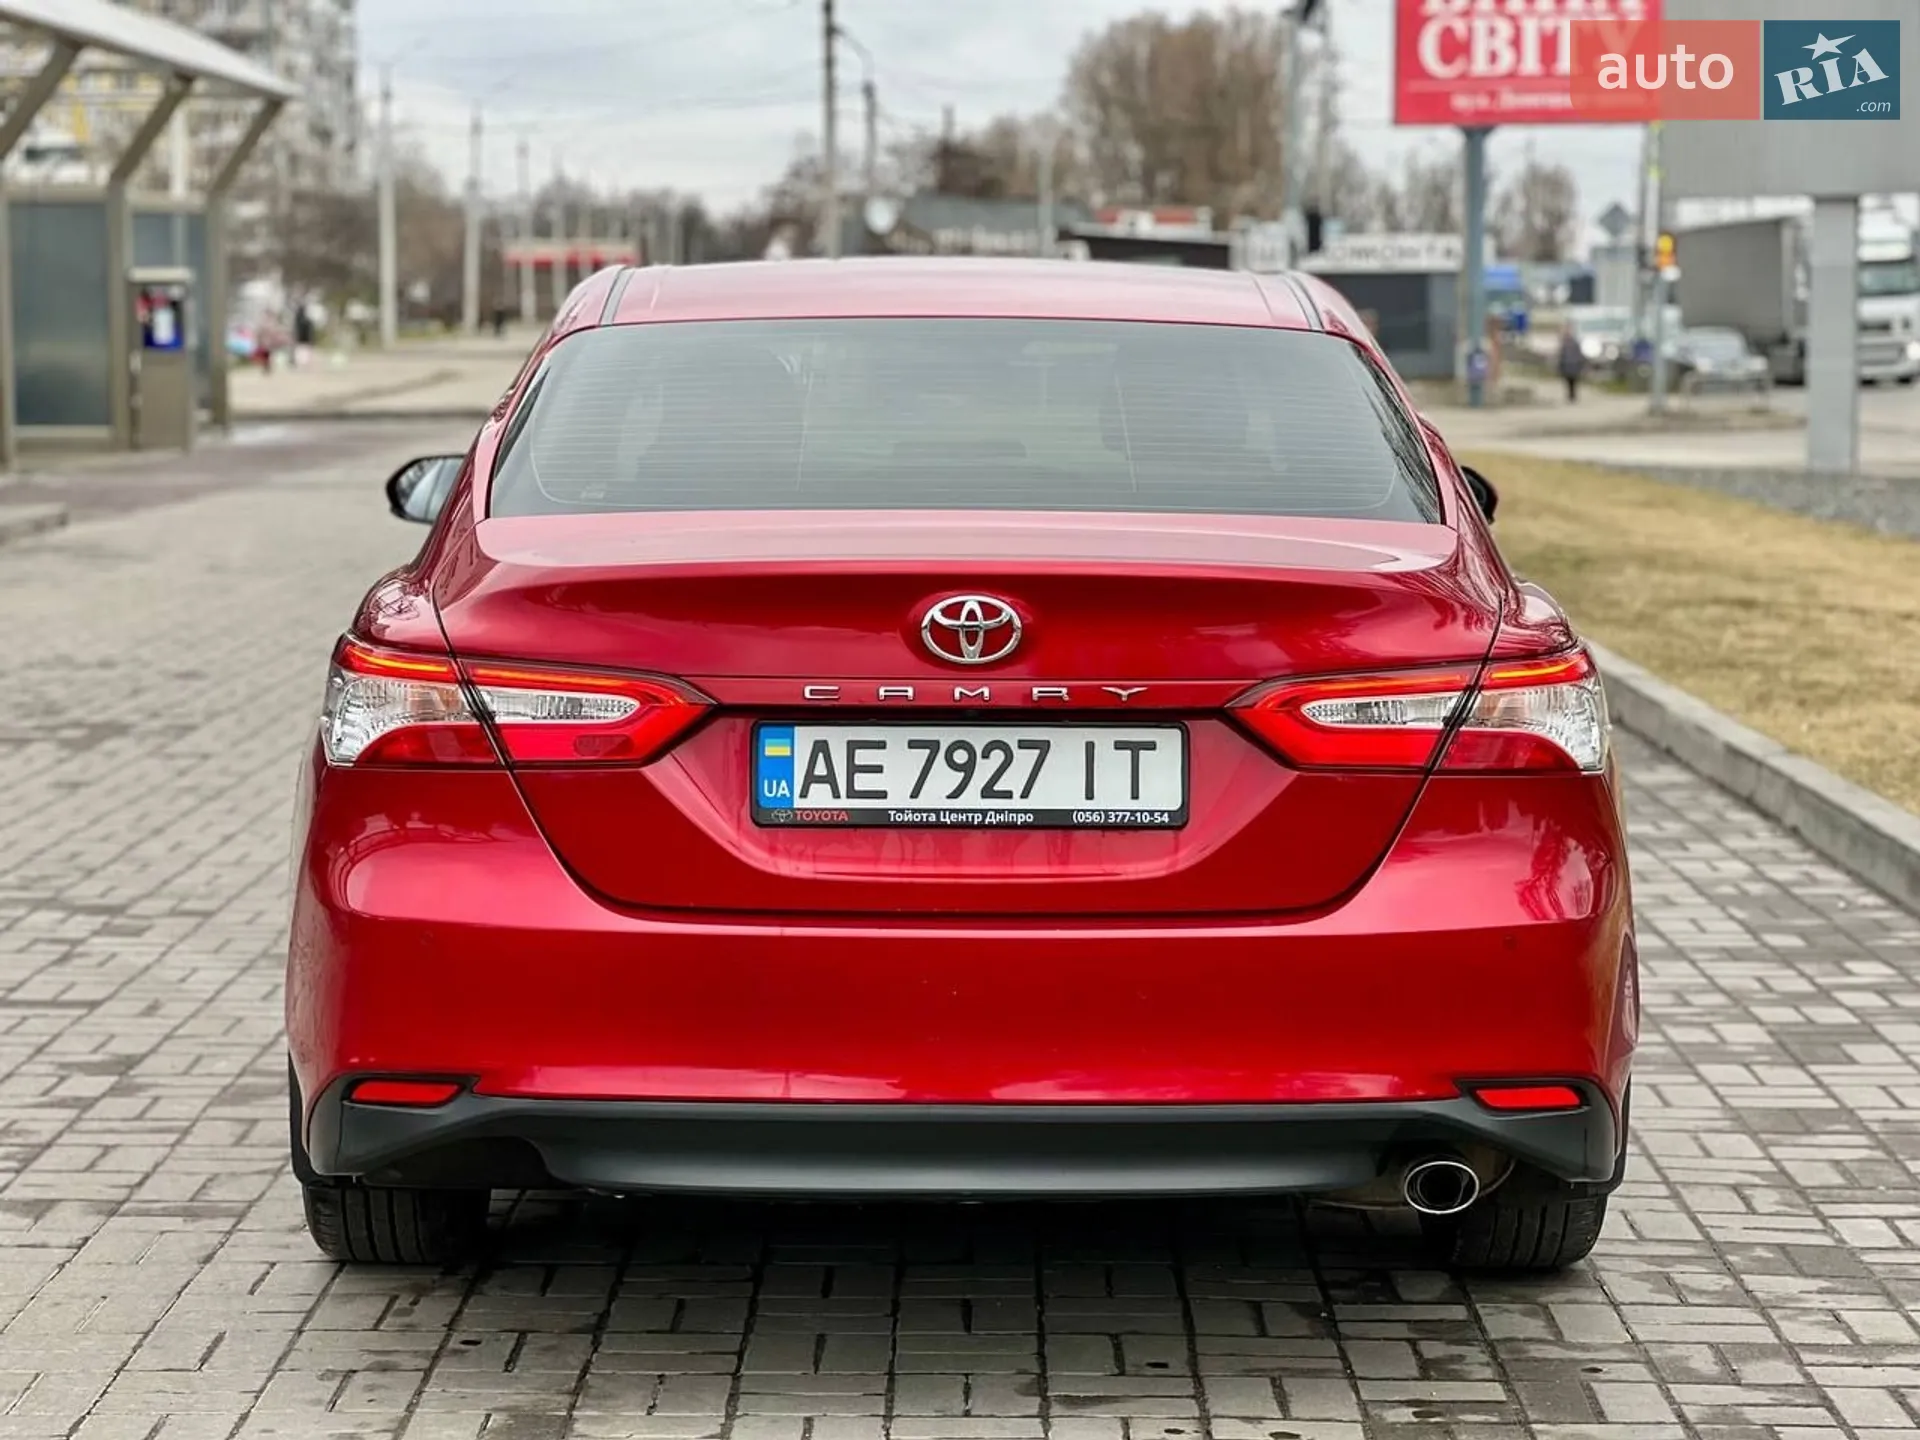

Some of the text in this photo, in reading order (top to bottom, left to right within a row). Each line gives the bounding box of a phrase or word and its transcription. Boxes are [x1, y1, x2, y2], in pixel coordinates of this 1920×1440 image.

[803, 685, 1149, 702] CAMRY
[798, 739, 1157, 801] AE 7927 IT
[763, 779, 791, 798] UA
[796, 809, 849, 821] TOYOTA
[888, 809, 1034, 824] Тойота Центр Дніпро
[1072, 811, 1170, 824] (056) 377-10-54
